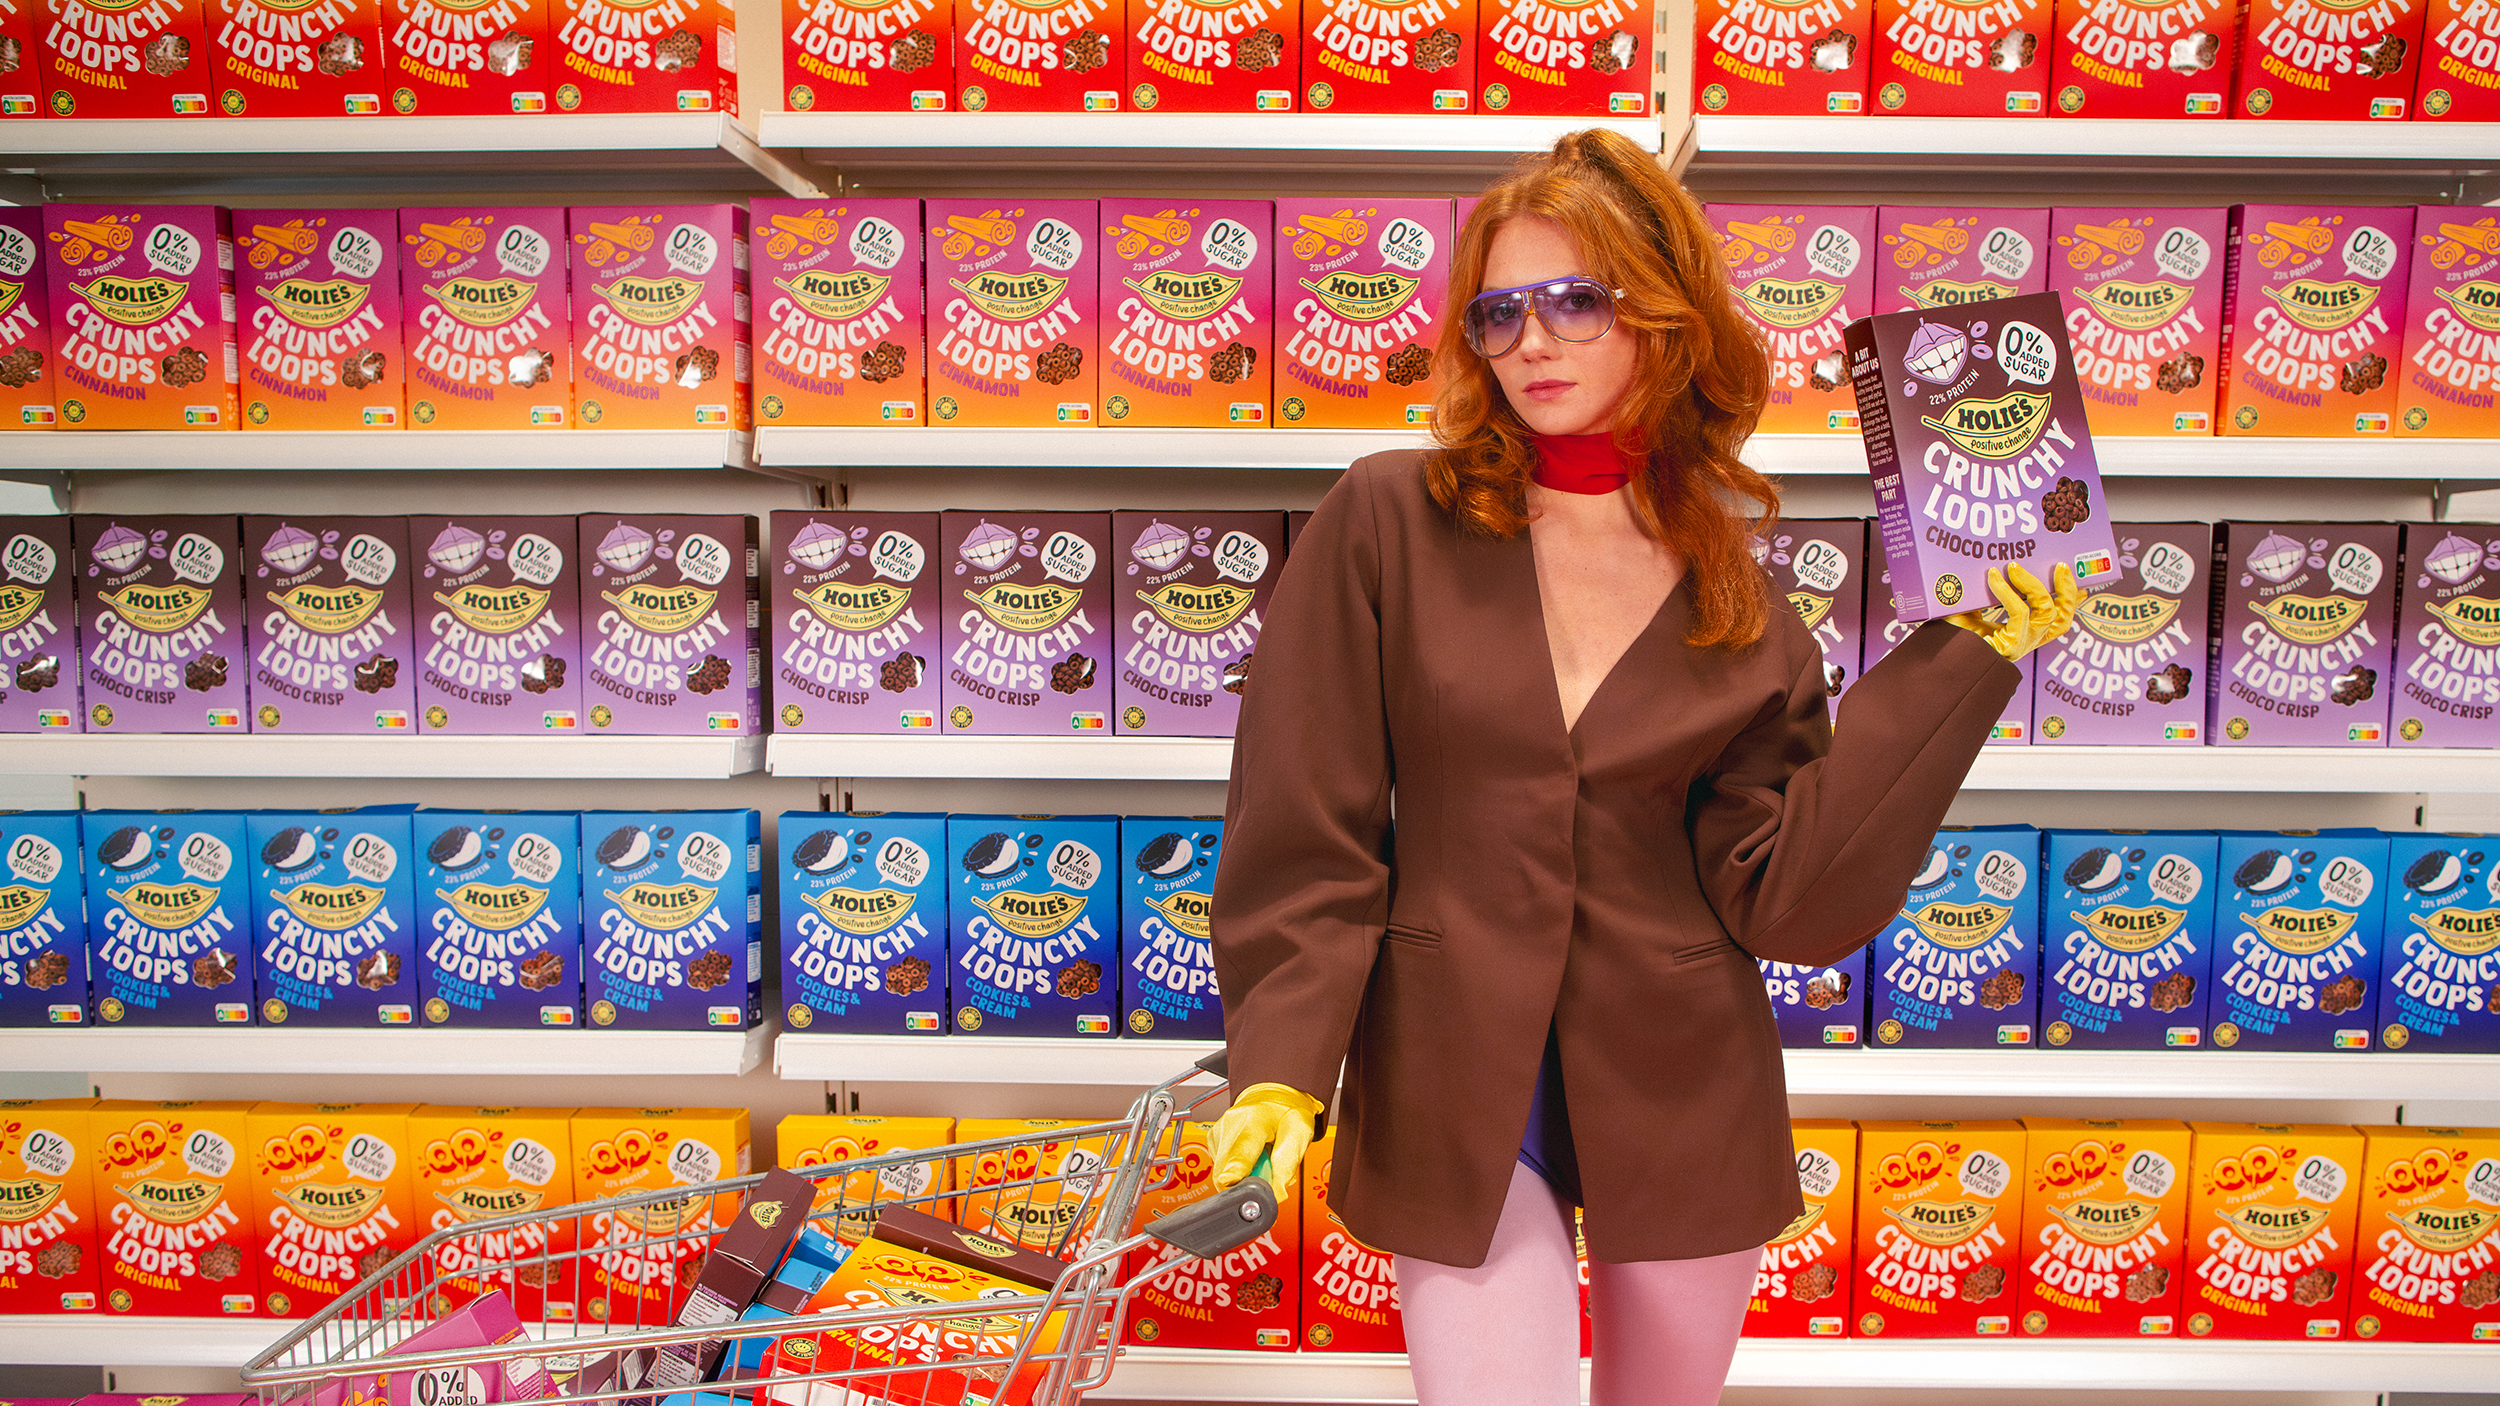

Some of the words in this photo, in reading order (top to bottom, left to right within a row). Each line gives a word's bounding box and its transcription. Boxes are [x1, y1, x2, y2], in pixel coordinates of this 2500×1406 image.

[45, 21, 141, 72] LOOPS
[790, 17, 885, 69] LOOPS
[2066, 15, 2164, 70] LOOPS
[54, 57, 128, 90] ORIGINAL
[797, 52, 869, 87] ORIGINAL
[2071, 51, 2144, 88] ORIGINAL
[858, 221, 893, 245] 0%
[2353, 231, 2388, 256] 0%
[783, 262, 798, 271] 23%
[798, 247, 831, 270] PROTEIN
[854, 242, 890, 267] SUGAR
[868, 241, 895, 258] ADDED
[2361, 251, 2387, 269] ADDED
[2289, 256, 2323, 279] PROTEIN
[2347, 252, 2381, 277] SUGAR
[98, 281, 169, 302] HOLIE'S
[802, 275, 871, 297] HOLIE'S
[2291, 284, 2360, 307] HOLIE'S
[810, 300, 839, 313] positive
[840, 299, 867, 312] change
[2296, 310, 2326, 323] positive
[2326, 309, 2354, 322] change
[65, 301, 204, 355] CRUNCHY
[769, 294, 904, 350] CRUNCHY
[2254, 305, 2389, 361] CRUNCHY
[2005, 326, 2043, 355] 0%
[762, 327, 855, 379] LOOPS
[1854, 351, 1860, 364] A
[1859, 346, 1869, 362] BIT
[2019, 351, 2050, 369] ADDED
[2243, 337, 2335, 390] LOOPS
[764, 360, 844, 396] CINNAMON
[1851, 360, 1870, 379] ABOUT
[1869, 357, 1880, 371] US
[2004, 356, 2046, 382] SUGAR
[64, 365, 146, 401] CINNAMON
[1929, 393, 1947, 406] 22%
[1946, 368, 1981, 401] PROTEIN
[2243, 370, 2322, 407] CINNAMON
[1957, 397, 2033, 431] HOLIE'S
[1970, 438, 2004, 451] positive
[2004, 427, 2032, 448] change
[1923, 417, 2076, 500] CRUNCHY
[1873, 477, 1886, 491] THE
[1884, 473, 1901, 488] BEST
[1881, 488, 1897, 503] PART
[1922, 483, 2038, 538] LOOPS
[178, 537, 212, 560] 0%
[879, 535, 914, 559] 0%
[1925, 525, 1984, 559] CHOCO
[1987, 538, 2036, 561] CRISP
[174, 558, 210, 581] SUGAR
[188, 556, 215, 572] ADDED
[803, 575, 818, 583] 22%
[818, 560, 851, 582] PROTEIN
[874, 556, 910, 579] SUGAR
[888, 554, 915, 571] ADDED
[2078, 564, 2085, 574] A
[2338, 547, 2373, 572] 0%
[121, 563, 152, 585] PROTEIN
[2275, 573, 2309, 594] PROTEIN
[2332, 568, 2368, 592] SUGAR
[2347, 567, 2373, 584] ADDED
[126, 589, 192, 610] HOLIE'S
[822, 587, 891, 608] HOLIE'S
[134, 613, 162, 625] positive
[163, 612, 189, 624] change
[830, 611, 859, 624] positive
[860, 610, 887, 623] change
[2278, 600, 2347, 621] HOLIE'S
[95, 607, 226, 661] CRUNCHY
[788, 606, 924, 660] CRUNCHY
[2284, 624, 2313, 637] positive
[2314, 623, 2341, 636] change
[2242, 619, 2378, 673] CRUNCHY
[89, 639, 180, 688] LOOPS
[781, 638, 874, 689] LOOPS
[89, 668, 133, 698] CHOCO
[135, 689, 176, 704] CRISP
[780, 668, 826, 699] CHOCO
[827, 689, 870, 705] CRISP
[2232, 651, 2325, 702] LOOPS
[2230, 681, 2275, 712] CHOCO
[2277, 702, 2319, 718] CRISP
[885, 841, 919, 864] 0%
[810, 879, 825, 888] 23%
[825, 866, 857, 887] PROTEIN
[880, 861, 915, 885] SUGAR
[894, 860, 921, 877] ADDED
[2158, 858, 2192, 882] 0%
[2097, 883, 2130, 904] PROTEIN
[2152, 879, 2187, 902] SUGAR
[2167, 878, 2192, 894] ADDED
[829, 892, 897, 913] HOLIE'S
[837, 915, 865, 928] positive
[866, 915, 892, 927] change
[2099, 909, 2167, 930] HOLIE'S
[797, 911, 929, 963] CRUNCHY
[2105, 933, 2134, 945] positive
[2134, 932, 2161, 944] change
[789, 941, 880, 991] LOOPS
[2064, 928, 2197, 981] CRUNCHY
[2053, 959, 2145, 1008] LOOPS
[800, 990, 846, 1016] CREAM
[2061, 1009, 2107, 1034] CREAM
[191, 1133, 223, 1155] 0%
[135, 1158, 165, 1178] PROTEIN
[187, 1153, 222, 1175] SUGAR
[200, 1151, 227, 1167] ADDED
[2133, 1154, 2166, 1176] 0%
[141, 1182, 206, 1202] HOLIE'S
[2072, 1178, 2105, 1198] PROTEIN
[2127, 1173, 2161, 1196] SUGAR
[2141, 1172, 2166, 1188] ADDED
[111, 1200, 239, 1250] CRUNCHY
[2074, 1203, 2141, 1223] HOLIE'S
[106, 1230, 195, 1277] LOOPS
[2040, 1221, 2170, 1272] CRUNCHY
[114, 1259, 182, 1292] ORIGINAL
[883, 1275, 902, 1284] 22%
[905, 1280, 951, 1291] PROTEIN
[2029, 1251, 2119, 1298] LOOPS
[2034, 1281, 2103, 1314] ORIGINAL
[417, 1369, 465, 1406] 0%
